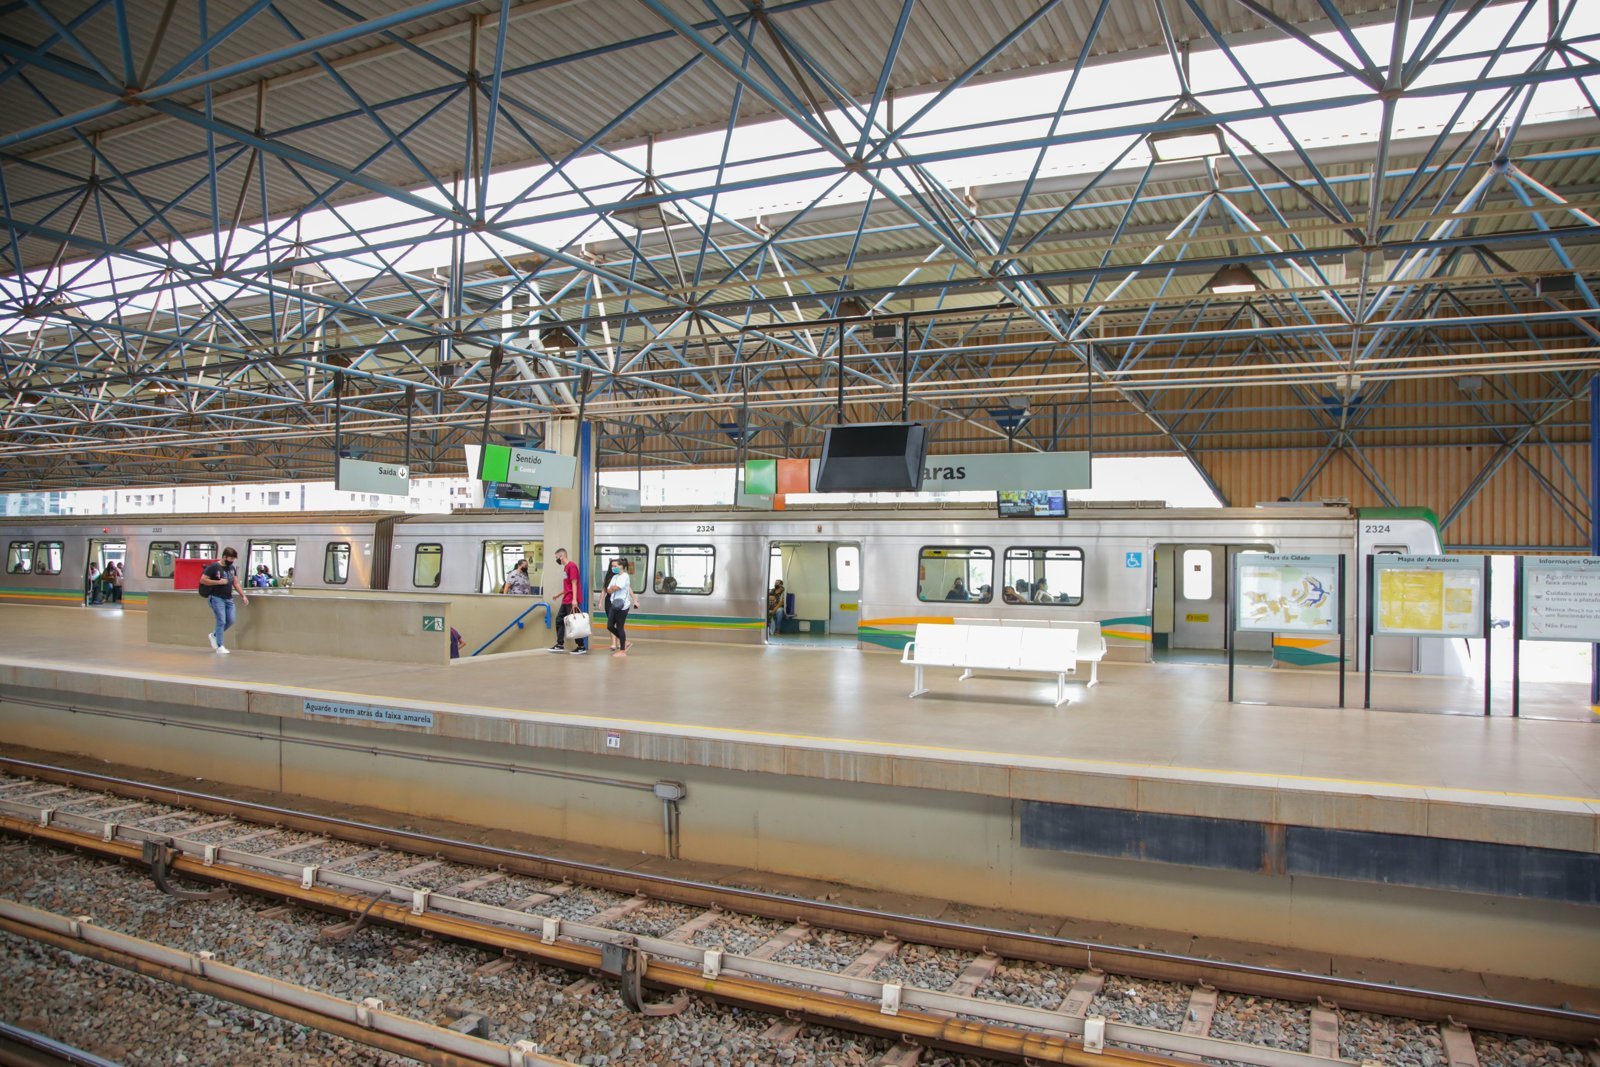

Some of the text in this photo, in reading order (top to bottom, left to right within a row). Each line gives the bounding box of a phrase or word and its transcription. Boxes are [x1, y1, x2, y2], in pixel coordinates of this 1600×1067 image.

[516, 453, 542, 465] Sentido
[378, 467, 397, 476] Saída
[696, 525, 715, 533] 2324
[1365, 524, 1391, 533] 2324
[305, 702, 331, 713] Aguarde
[339, 707, 355, 715] trem
[374, 710, 383, 718] da
[385, 711, 401, 720] faixa
[403, 714, 431, 724] amarela
